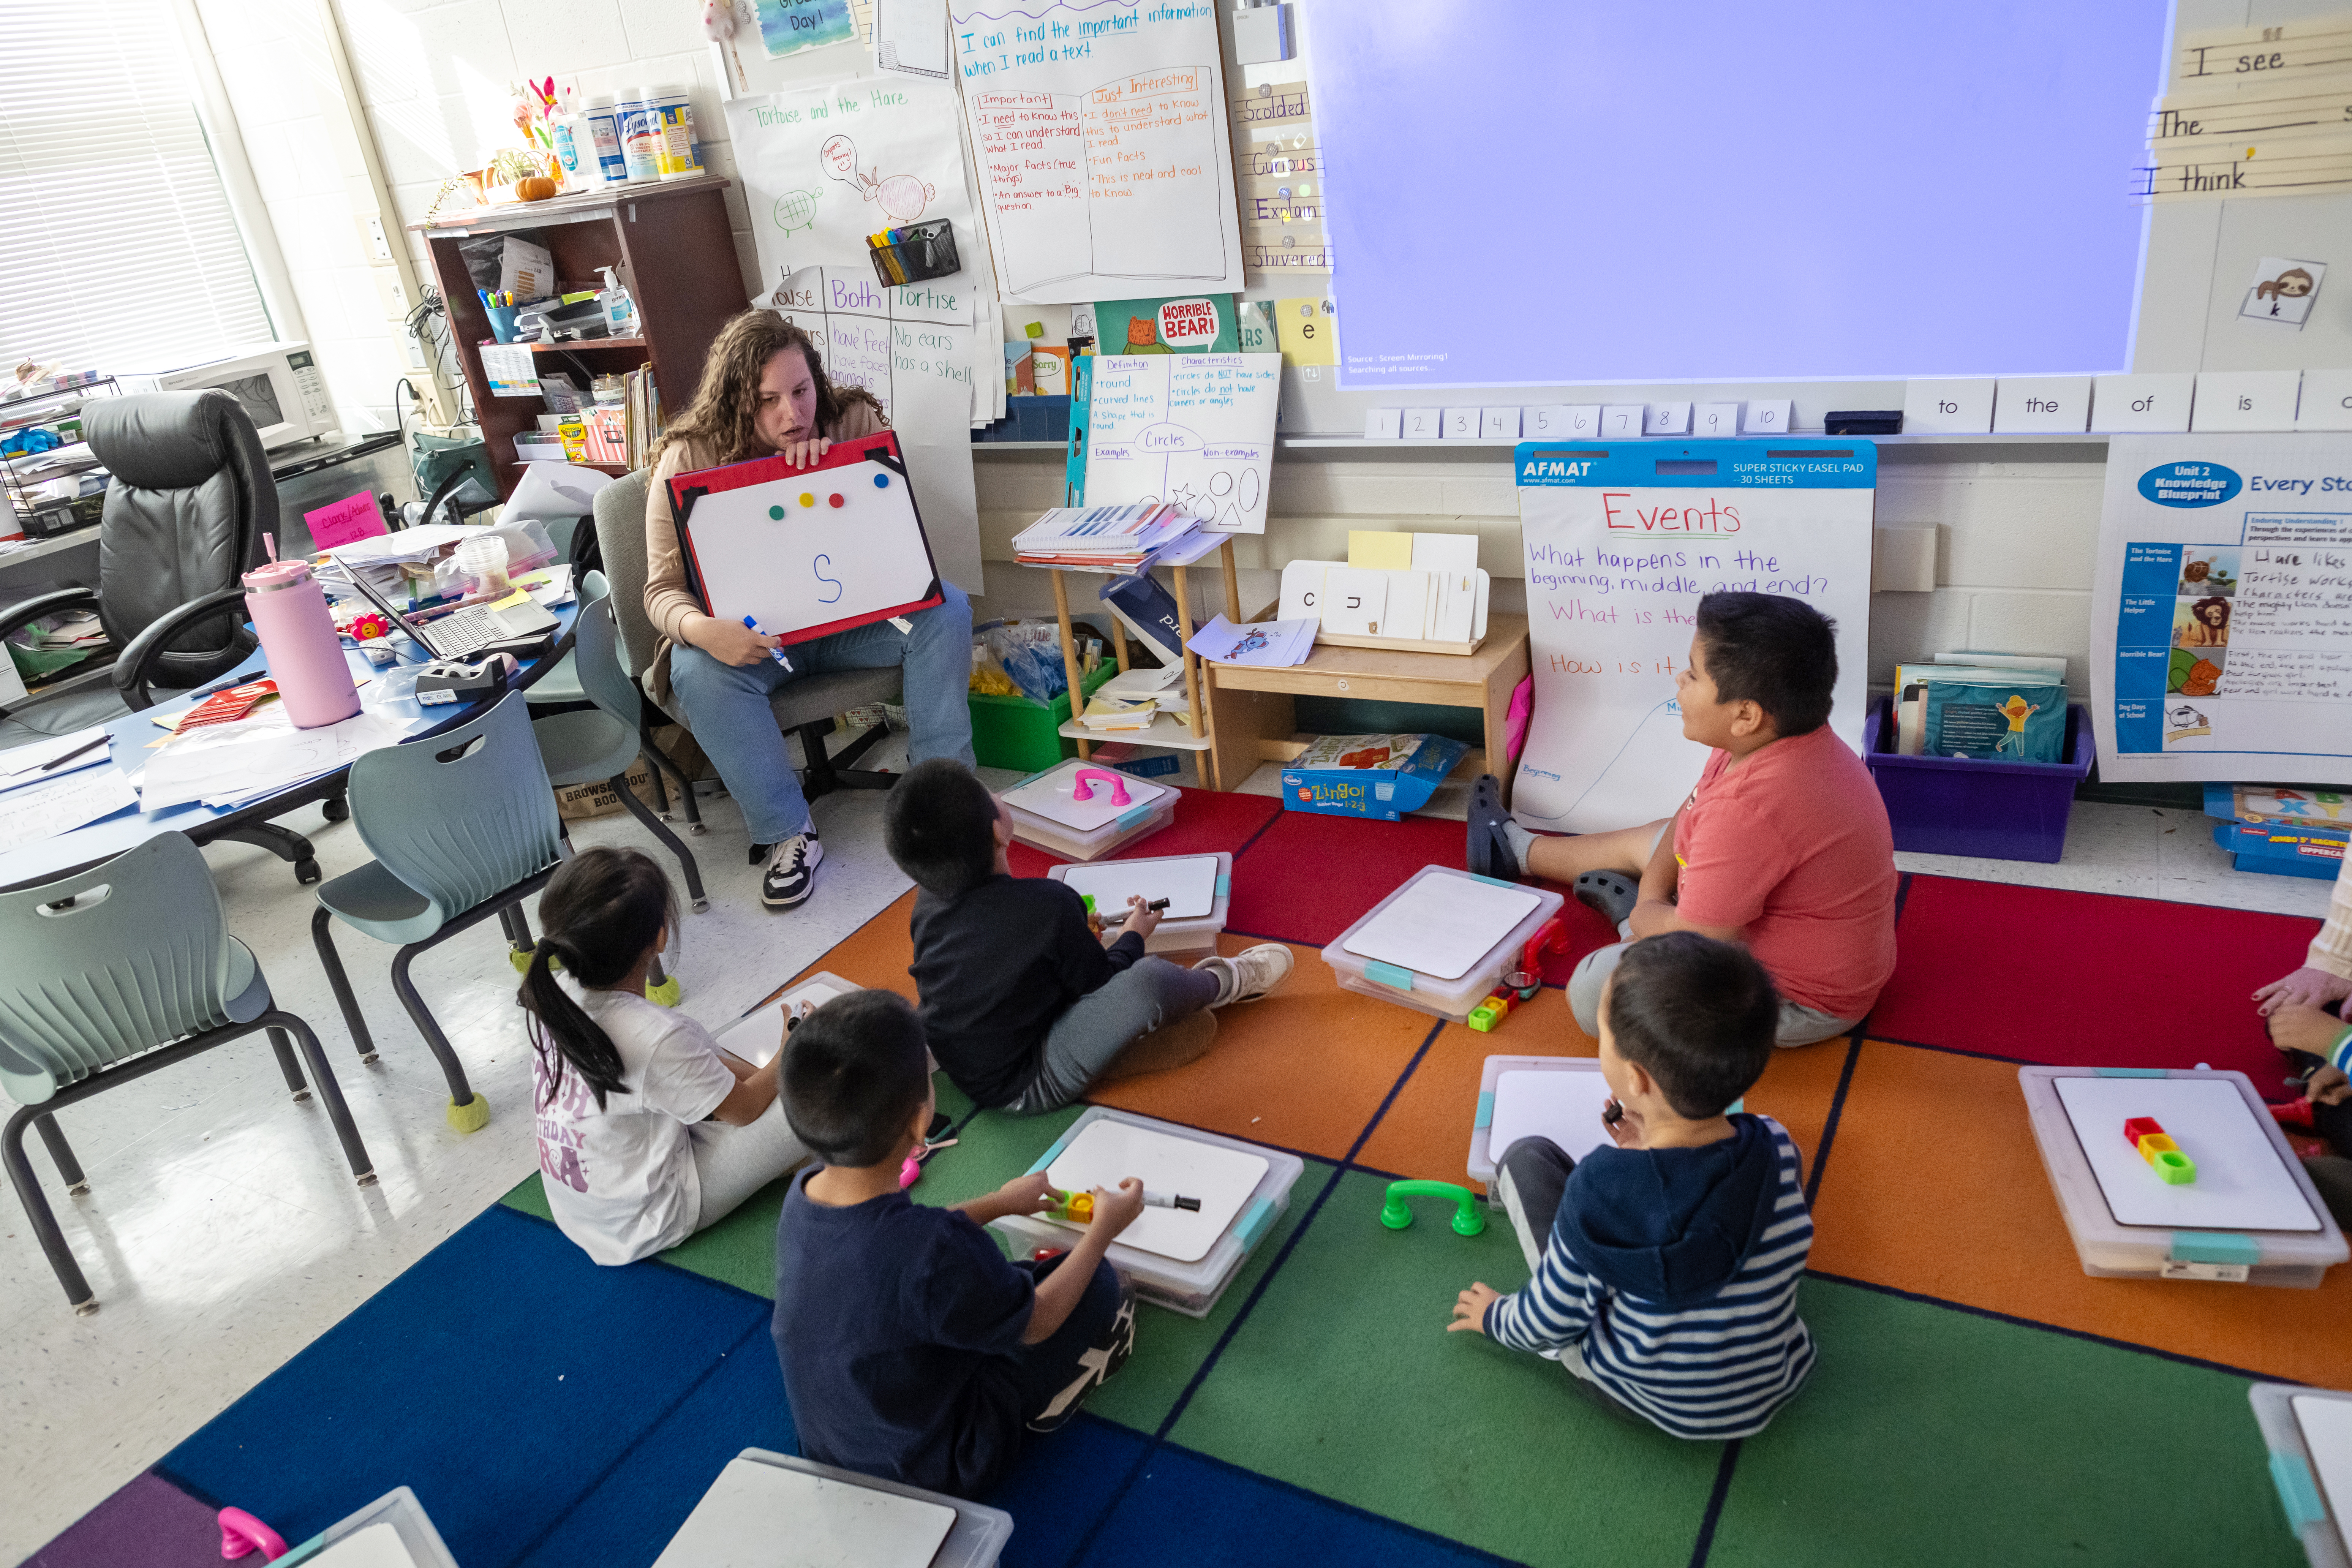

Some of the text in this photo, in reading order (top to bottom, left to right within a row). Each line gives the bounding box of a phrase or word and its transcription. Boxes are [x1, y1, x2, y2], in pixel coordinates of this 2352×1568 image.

[983, 5, 1212, 49] can find the important information
[964, 41, 1094, 77] when read text.
[2189, 47, 2284, 76] I see
[1095, 73, 1194, 102] Just Interesting
[982, 93, 1049, 105] Important
[749, 90, 908, 128] Tortoise and the Hare
[1102, 103, 1152, 119] don't need
[1244, 95, 1305, 121] Scolded
[994, 110, 1078, 124] need this
[1086, 112, 1208, 136] this understand what
[2157, 110, 2203, 138] The
[1025, 123, 1080, 139] understand
[1021, 138, 1045, 150] read.
[1098, 135, 1121, 147] read.
[993, 159, 1076, 175] Major facts (true
[1092, 155, 1112, 166] Fun
[1253, 153, 1315, 175] Curious
[993, 172, 1023, 186] things)
[1095, 164, 1202, 184] This neat and cool
[2180, 161, 2246, 191] think
[1013, 184, 1079, 199] answer Big
[997, 202, 1034, 214] question.
[1256, 195, 1317, 225] Explain
[1252, 247, 1326, 268] Shivered
[832, 280, 881, 308] Both
[897, 285, 957, 310] Tortise
[1162, 302, 1212, 320] HORRIBLE
[2271, 303, 2281, 316] k
[1165, 319, 1215, 338] BEAR!
[1303, 323, 1315, 338] e
[865, 329, 890, 353] feet
[895, 326, 952, 350] No ears
[834, 354, 888, 375] have faces
[895, 352, 915, 370] has
[1033, 359, 1056, 370] Sorry
[1107, 360, 1148, 370] Definition
[1181, 356, 1242, 365] Characteristics
[1176, 371, 1200, 379] circles
[1236, 370, 1253, 379] have
[1256, 370, 1275, 379] sides
[1348, 366, 1386, 374] Searching
[831, 370, 874, 388] animals
[1100, 376, 1130, 388] round
[1176, 384, 1255, 396] circles not have
[1099, 394, 1154, 405] curved lines
[1170, 397, 1234, 408] corners angles
[1939, 399, 1957, 414] to
[2025, 397, 2058, 414] the
[2132, 396, 2154, 413] of
[2238, 394, 2252, 410] is
[1414, 417, 1425, 431] 2
[1457, 416, 1467, 432] 3
[1494, 417, 1502, 431] 4
[1538, 412, 1547, 429] 5
[1574, 413, 1586, 429] 6
[1617, 414, 1628, 429] 7
[1660, 411, 1669, 425] 8
[1709, 414, 1717, 432] 9
[1760, 410, 1774, 424] 10
[1092, 421, 1115, 430] round.
[1146, 432, 1184, 447] Circles
[1095, 448, 1130, 457] Examples
[1203, 448, 1259, 459] Non-examples
[1523, 462, 1590, 476] AFMAT
[1734, 464, 1805, 472] SUPER STICKY
[2175, 466, 2209, 476] Unit 2
[2155, 479, 2226, 489] Knowledge
[2251, 476, 2313, 495] Every
[2158, 490, 2220, 500] Blueprint
[1602, 493, 1741, 533] Events
[1529, 543, 1780, 573] What happens the
[1532, 568, 1614, 594] beginning,
[1712, 579, 1756, 593] and
[1766, 577, 1828, 594] end?
[1548, 599, 1696, 626] What is the
[1550, 654, 1601, 674] How
[1523, 763, 1562, 781] Beginning
[1312, 783, 1365, 801] Zingo!
[1345, 801, 1366, 811] 1-2-3
